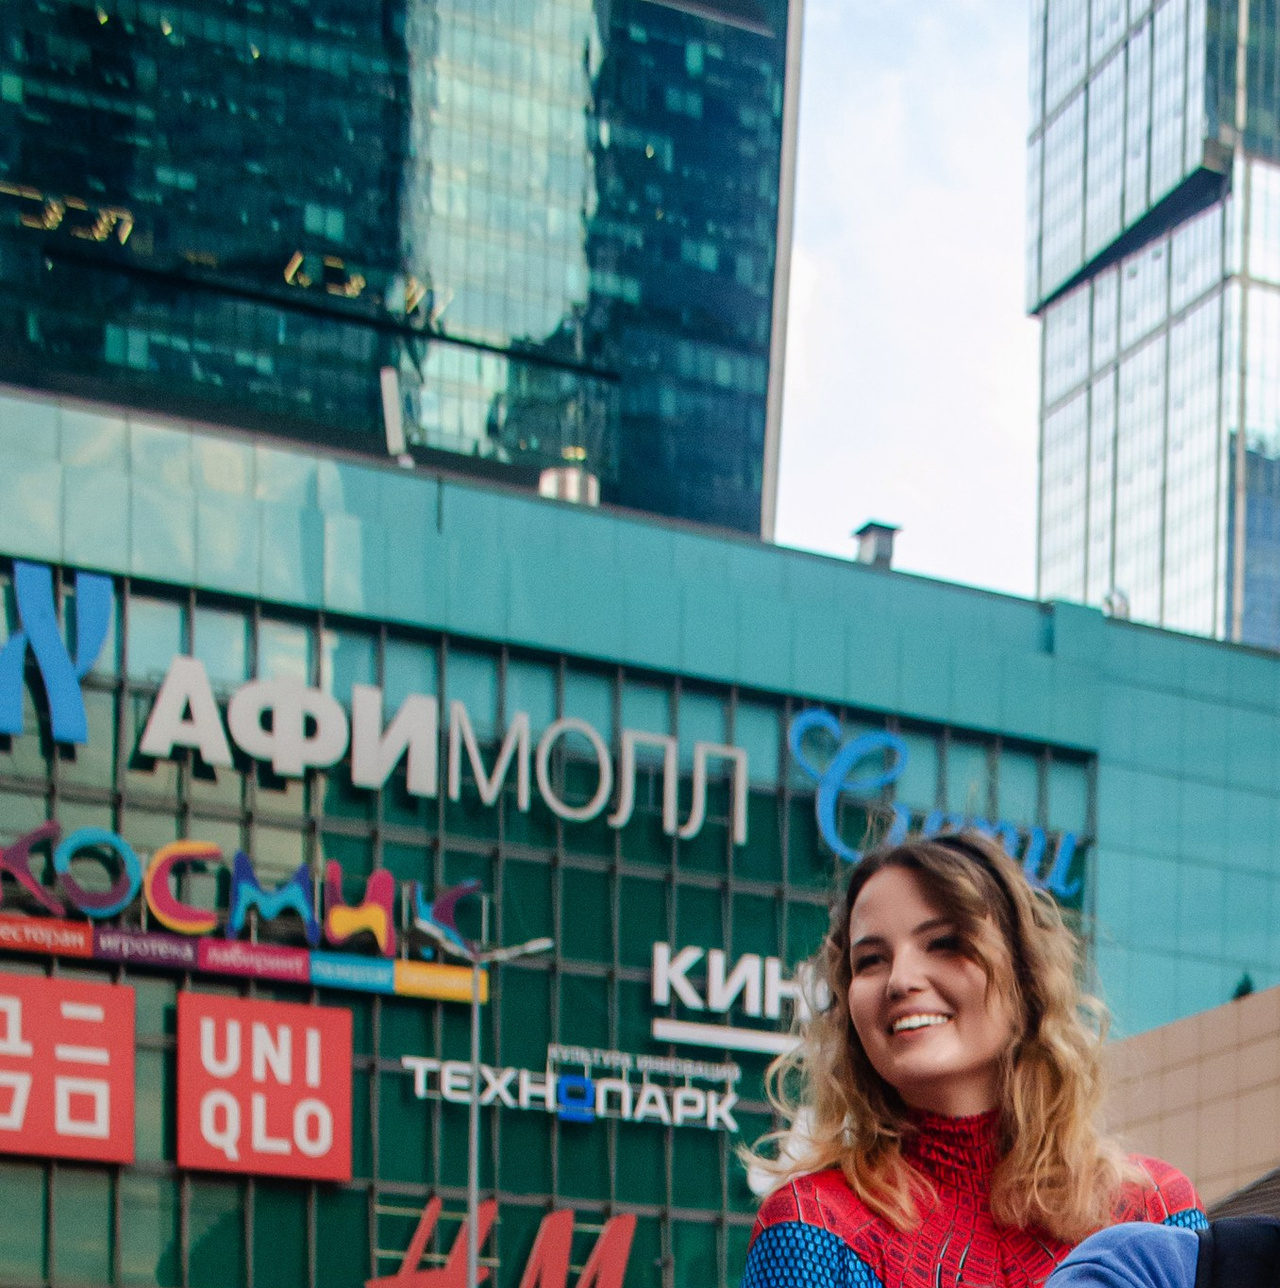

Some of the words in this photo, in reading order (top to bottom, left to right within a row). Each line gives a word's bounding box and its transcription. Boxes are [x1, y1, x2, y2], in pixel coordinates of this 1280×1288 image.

[138, 655, 749, 846] АФИМОЛЛ
[200, 1015, 322, 1087] UNI
[200, 1089, 334, 1161] QLO
[400, 1054, 740, 1134] ТЕХНОПАРК
